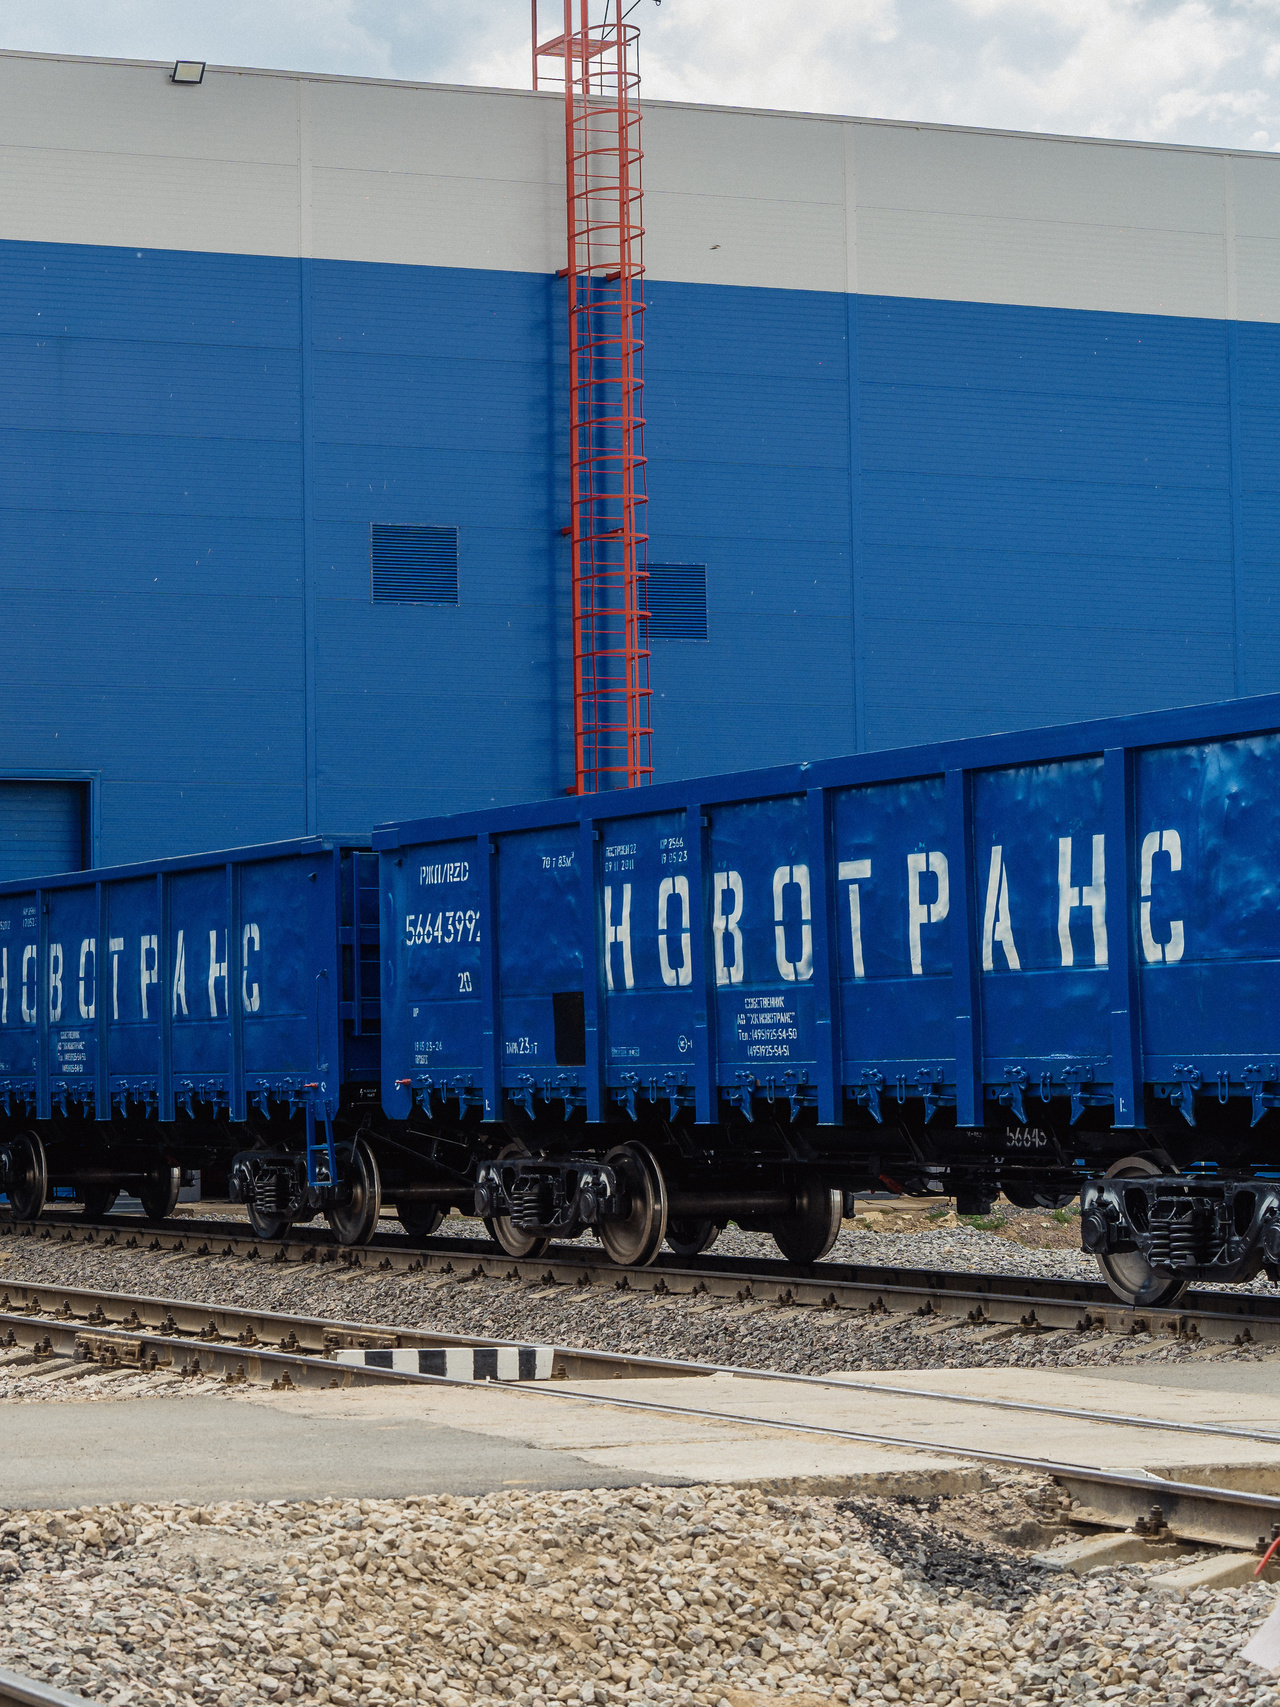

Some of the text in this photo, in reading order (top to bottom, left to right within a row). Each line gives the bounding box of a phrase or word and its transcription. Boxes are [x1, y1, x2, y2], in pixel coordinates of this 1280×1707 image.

[542, 856, 551, 869] 70
[604, 829, 1185, 991] НОВОТРАНС
[458, 971, 472, 992] 20
